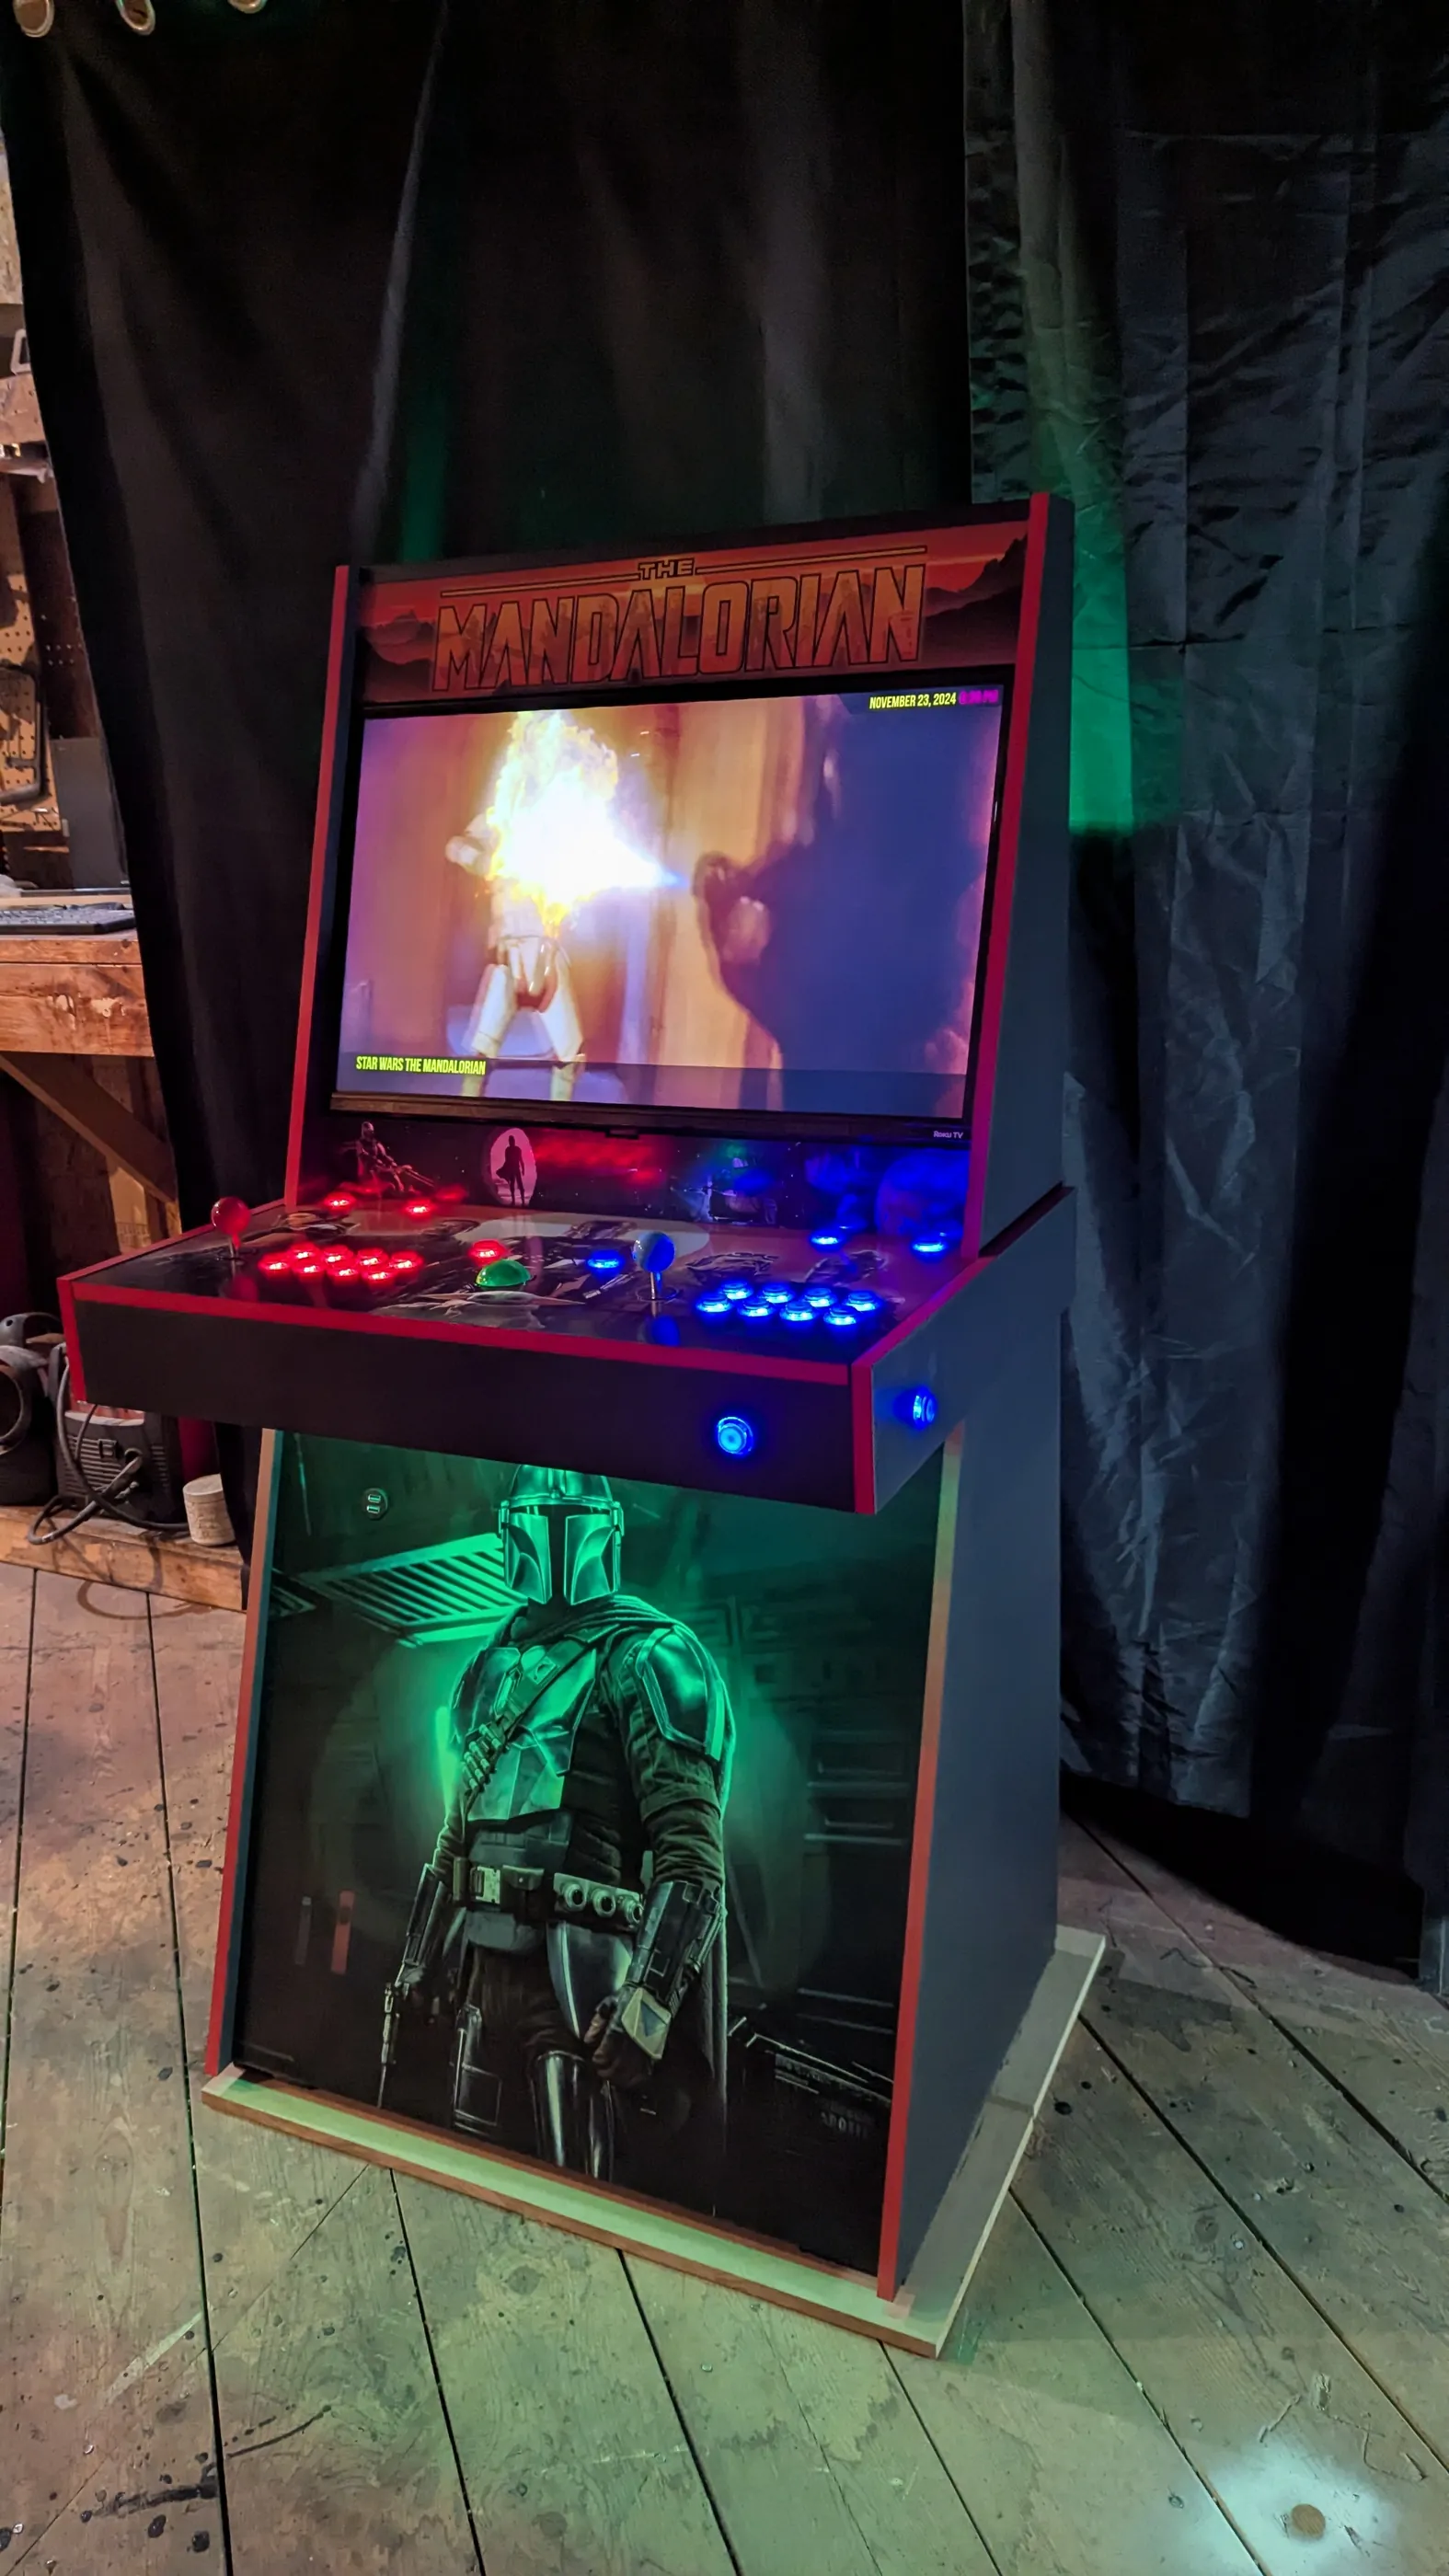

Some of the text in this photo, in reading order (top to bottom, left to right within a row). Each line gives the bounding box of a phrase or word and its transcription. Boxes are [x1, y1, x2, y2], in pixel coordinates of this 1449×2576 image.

[638, 558, 696, 579] THE
[432, 564, 926, 693] MANDALORIAN
[869, 696, 916, 709] NOVEMBER
[917, 694, 932, 707] 23,
[933, 692, 957, 706] 2024
[356, 1056, 486, 1075] STAR WARS THE MANDALORIAN
